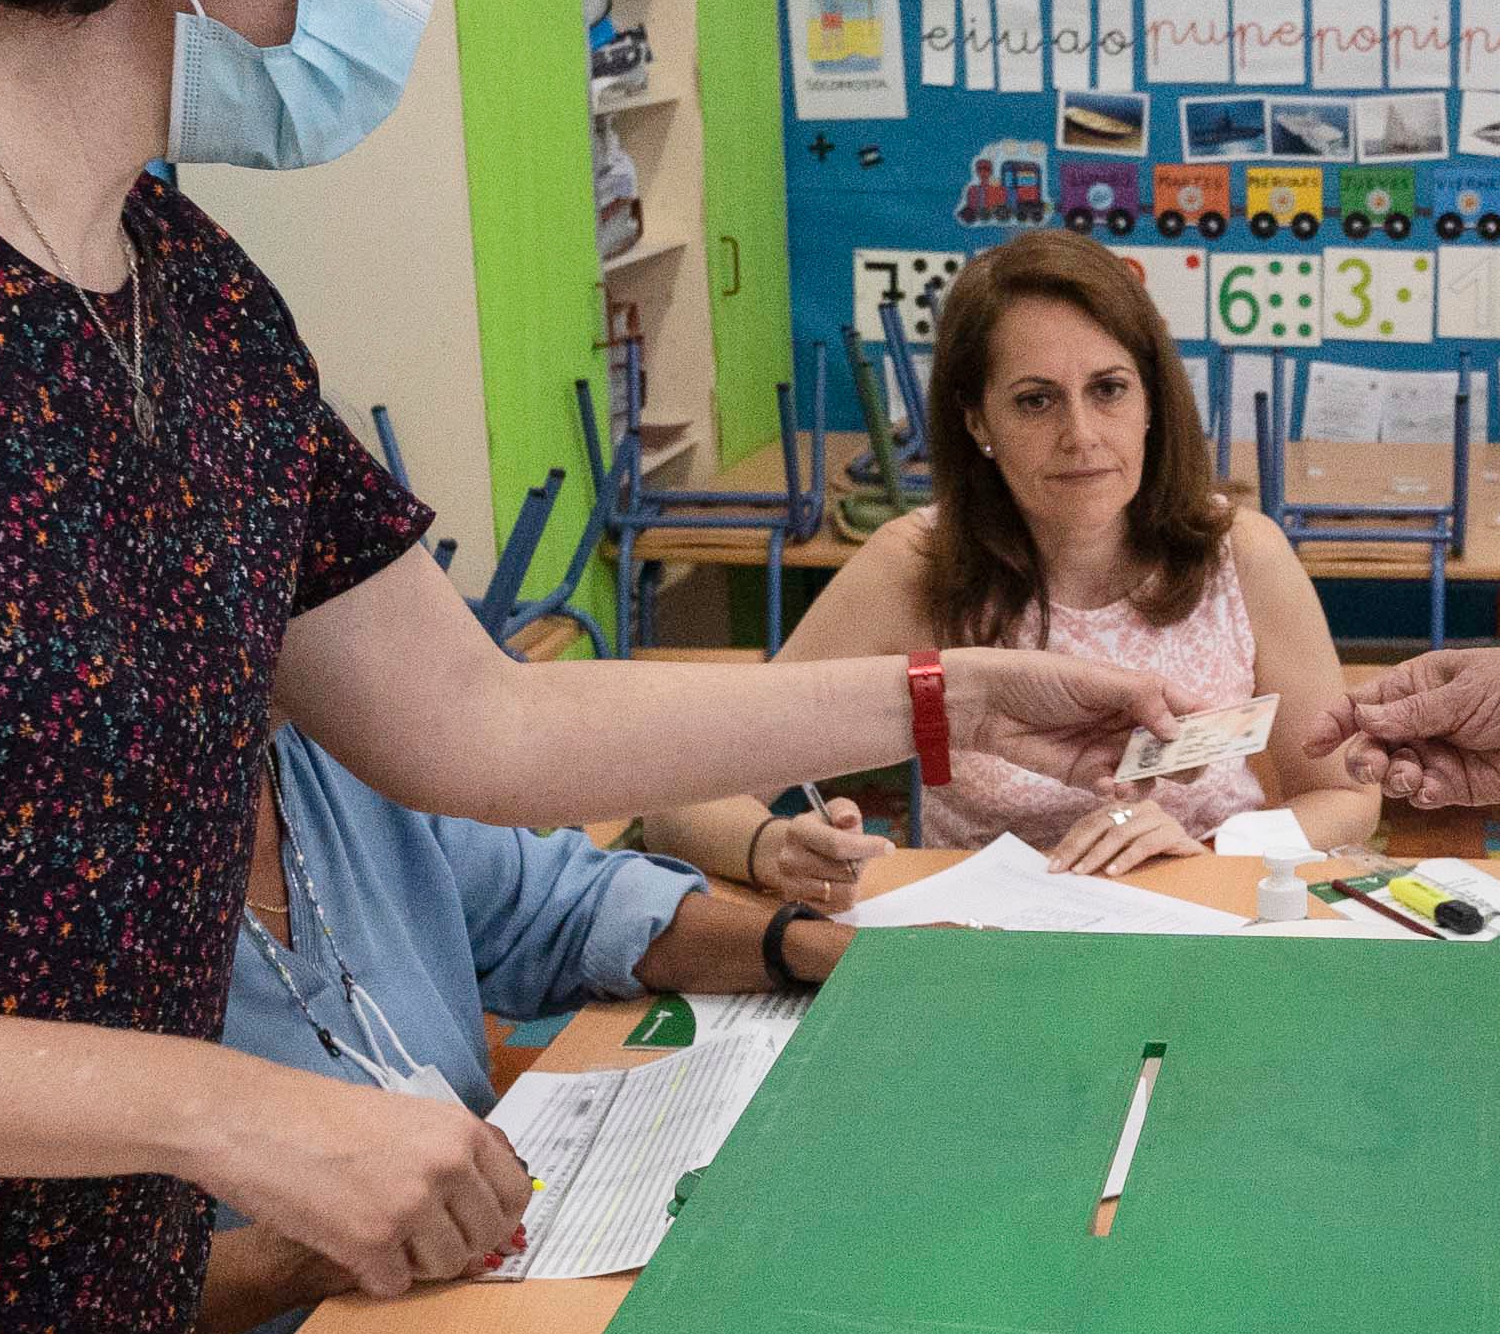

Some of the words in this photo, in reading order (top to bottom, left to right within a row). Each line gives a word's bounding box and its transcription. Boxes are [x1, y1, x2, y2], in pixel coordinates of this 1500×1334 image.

[922, 24, 956, 53] e
[1052, 27, 1092, 54] a
[1099, 28, 1134, 55] o
[1146, 18, 1231, 67] pu
[1233, 20, 1304, 69] pe
[1310, 17, 1383, 73] po
[1385, 14, 1450, 73] pi
[1218, 266, 1262, 337] 6
[1333, 257, 1373, 329] 3
